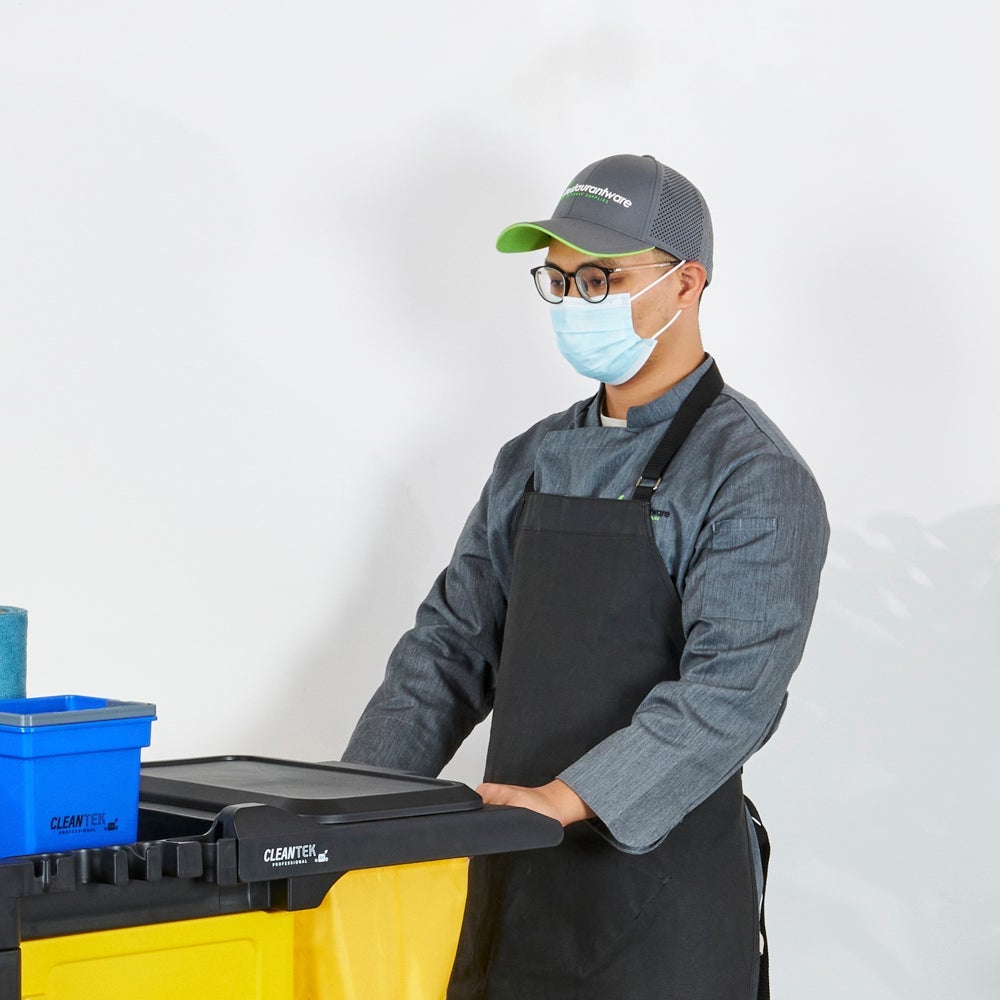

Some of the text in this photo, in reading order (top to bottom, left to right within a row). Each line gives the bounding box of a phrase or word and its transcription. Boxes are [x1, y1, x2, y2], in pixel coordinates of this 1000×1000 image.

[50, 812, 106, 830] CLEANTEK
[263, 844, 317, 862] CLEANTEK
[272, 859, 308, 867] PROFESSIONAL
